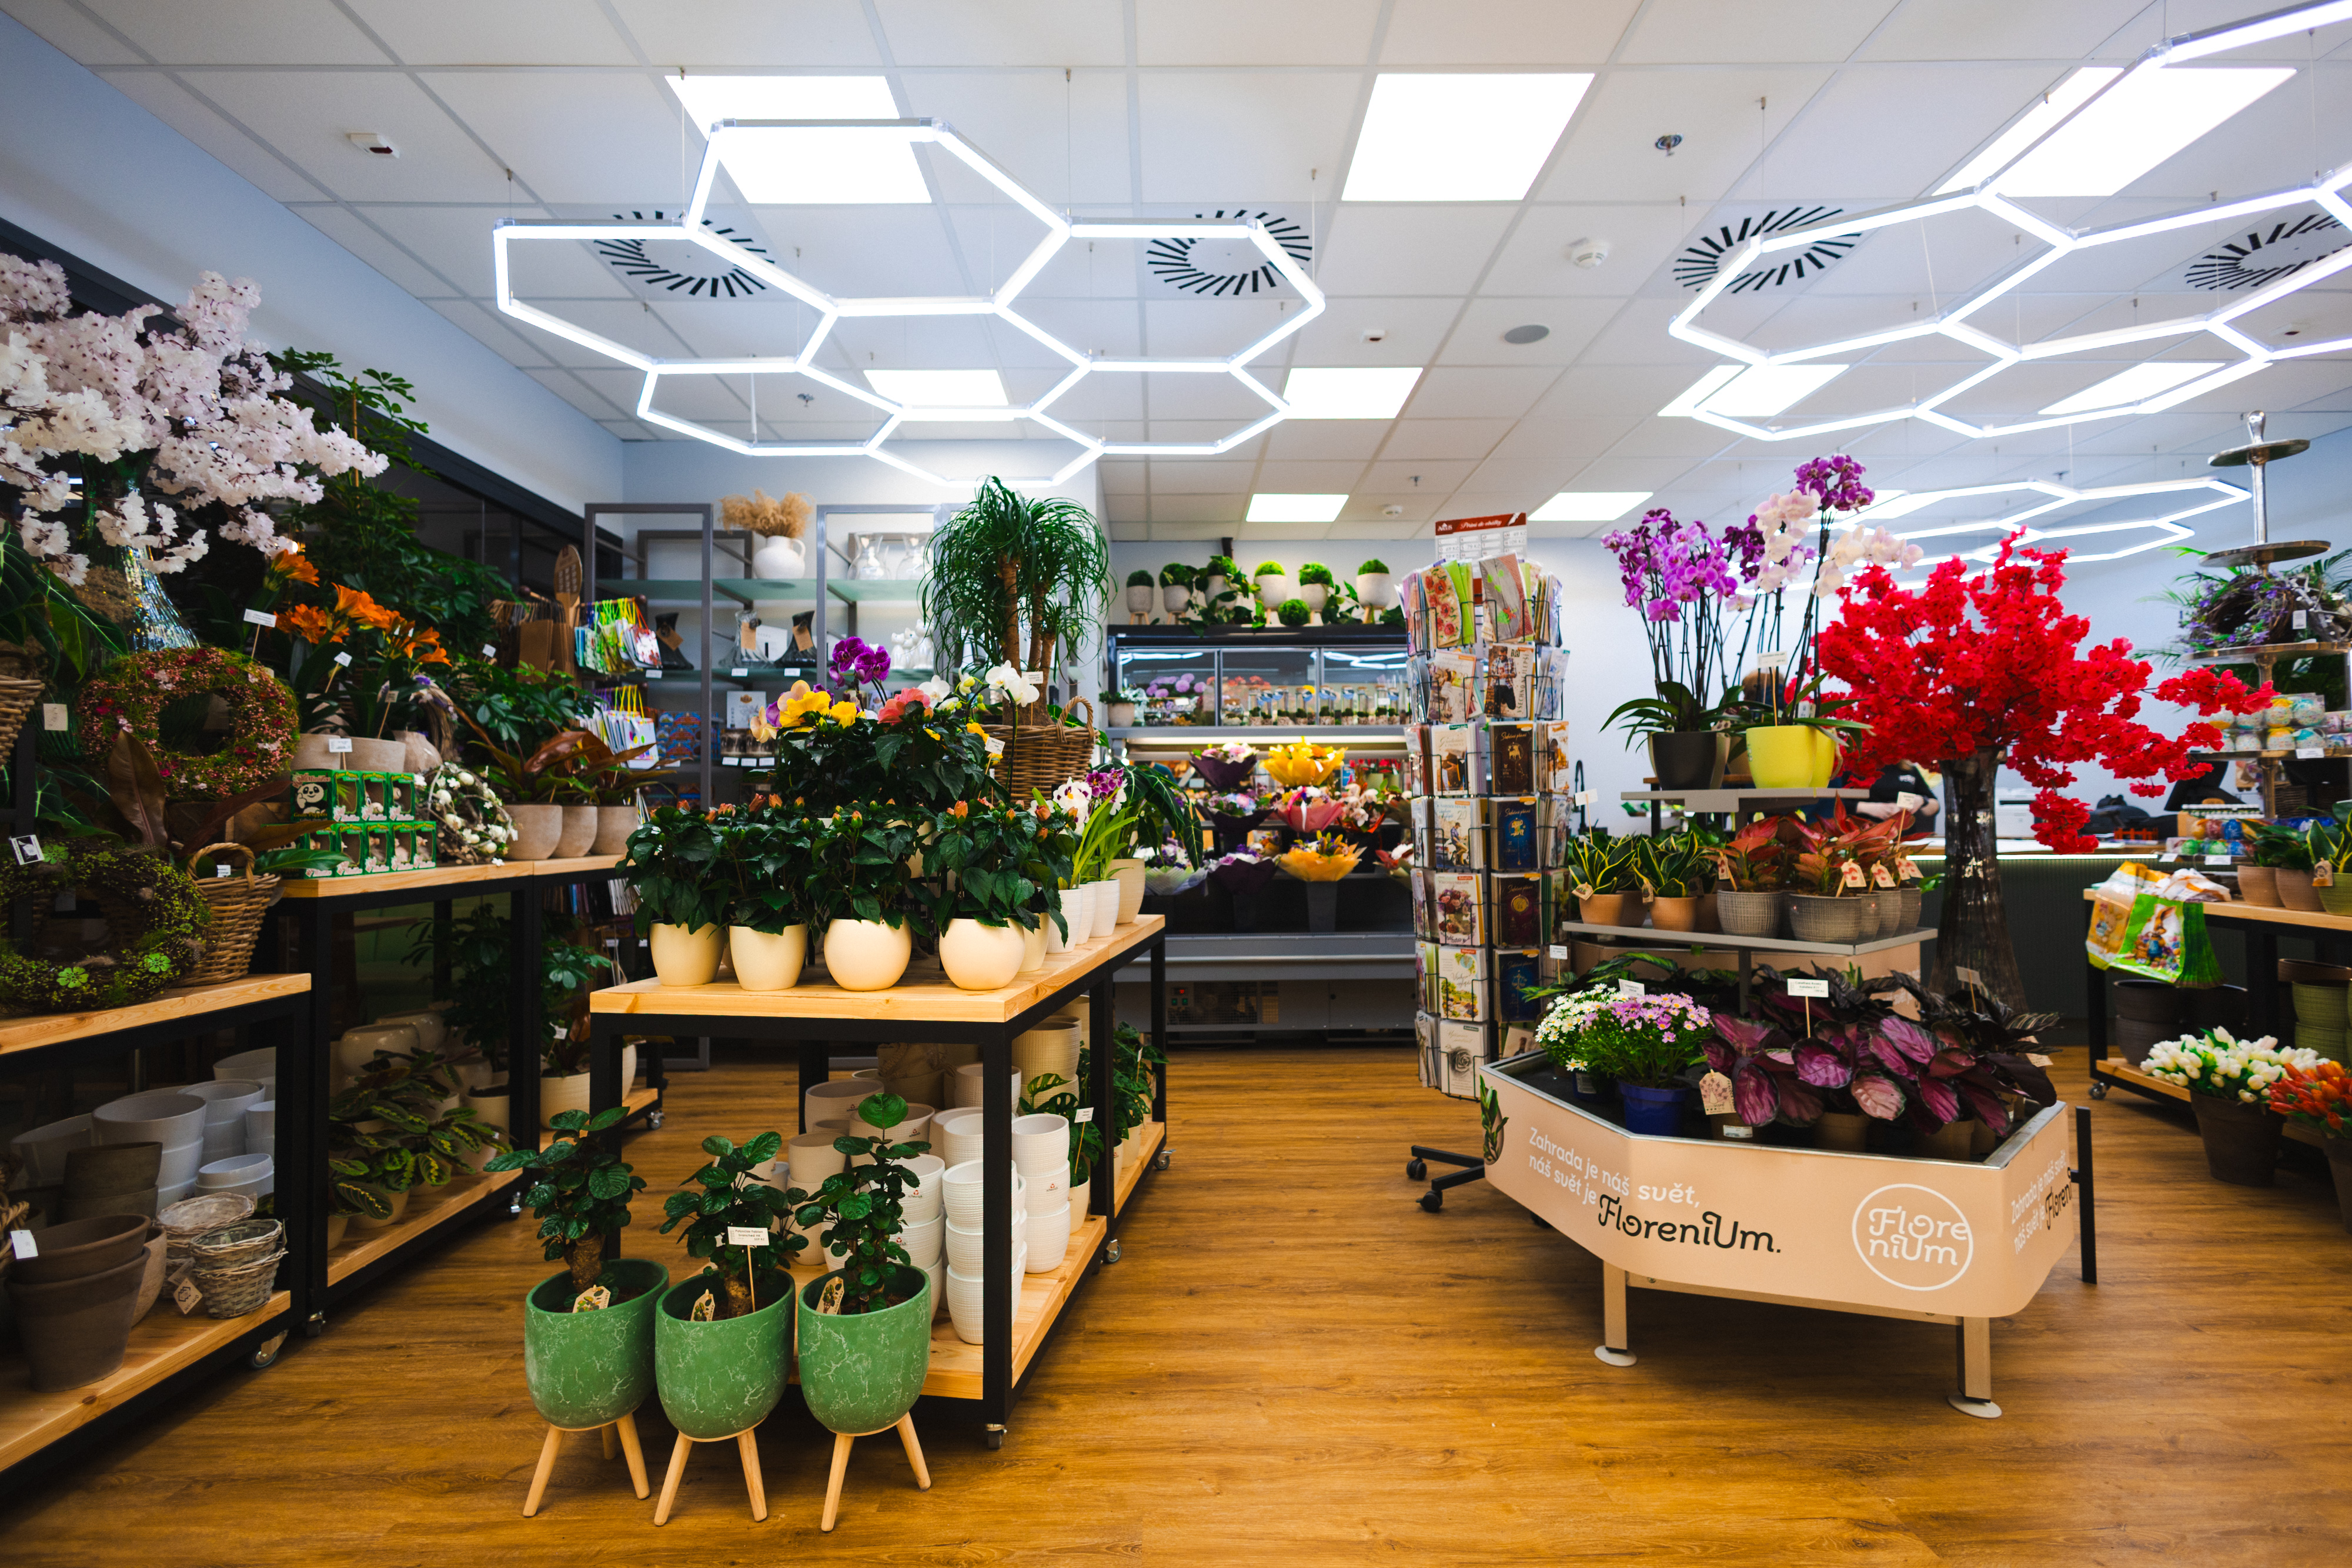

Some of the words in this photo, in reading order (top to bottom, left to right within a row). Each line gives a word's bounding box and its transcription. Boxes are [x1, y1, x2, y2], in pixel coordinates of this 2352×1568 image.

[1529, 1126, 1583, 1171] Zahrada
[1584, 1157, 1599, 1179] je
[1602, 1169, 1630, 1196] náš
[1638, 1182, 1700, 1208] svět,
[1529, 1155, 1552, 1178] náš
[1553, 1169, 1582, 1196] svět
[1582, 1183, 1597, 1205] je
